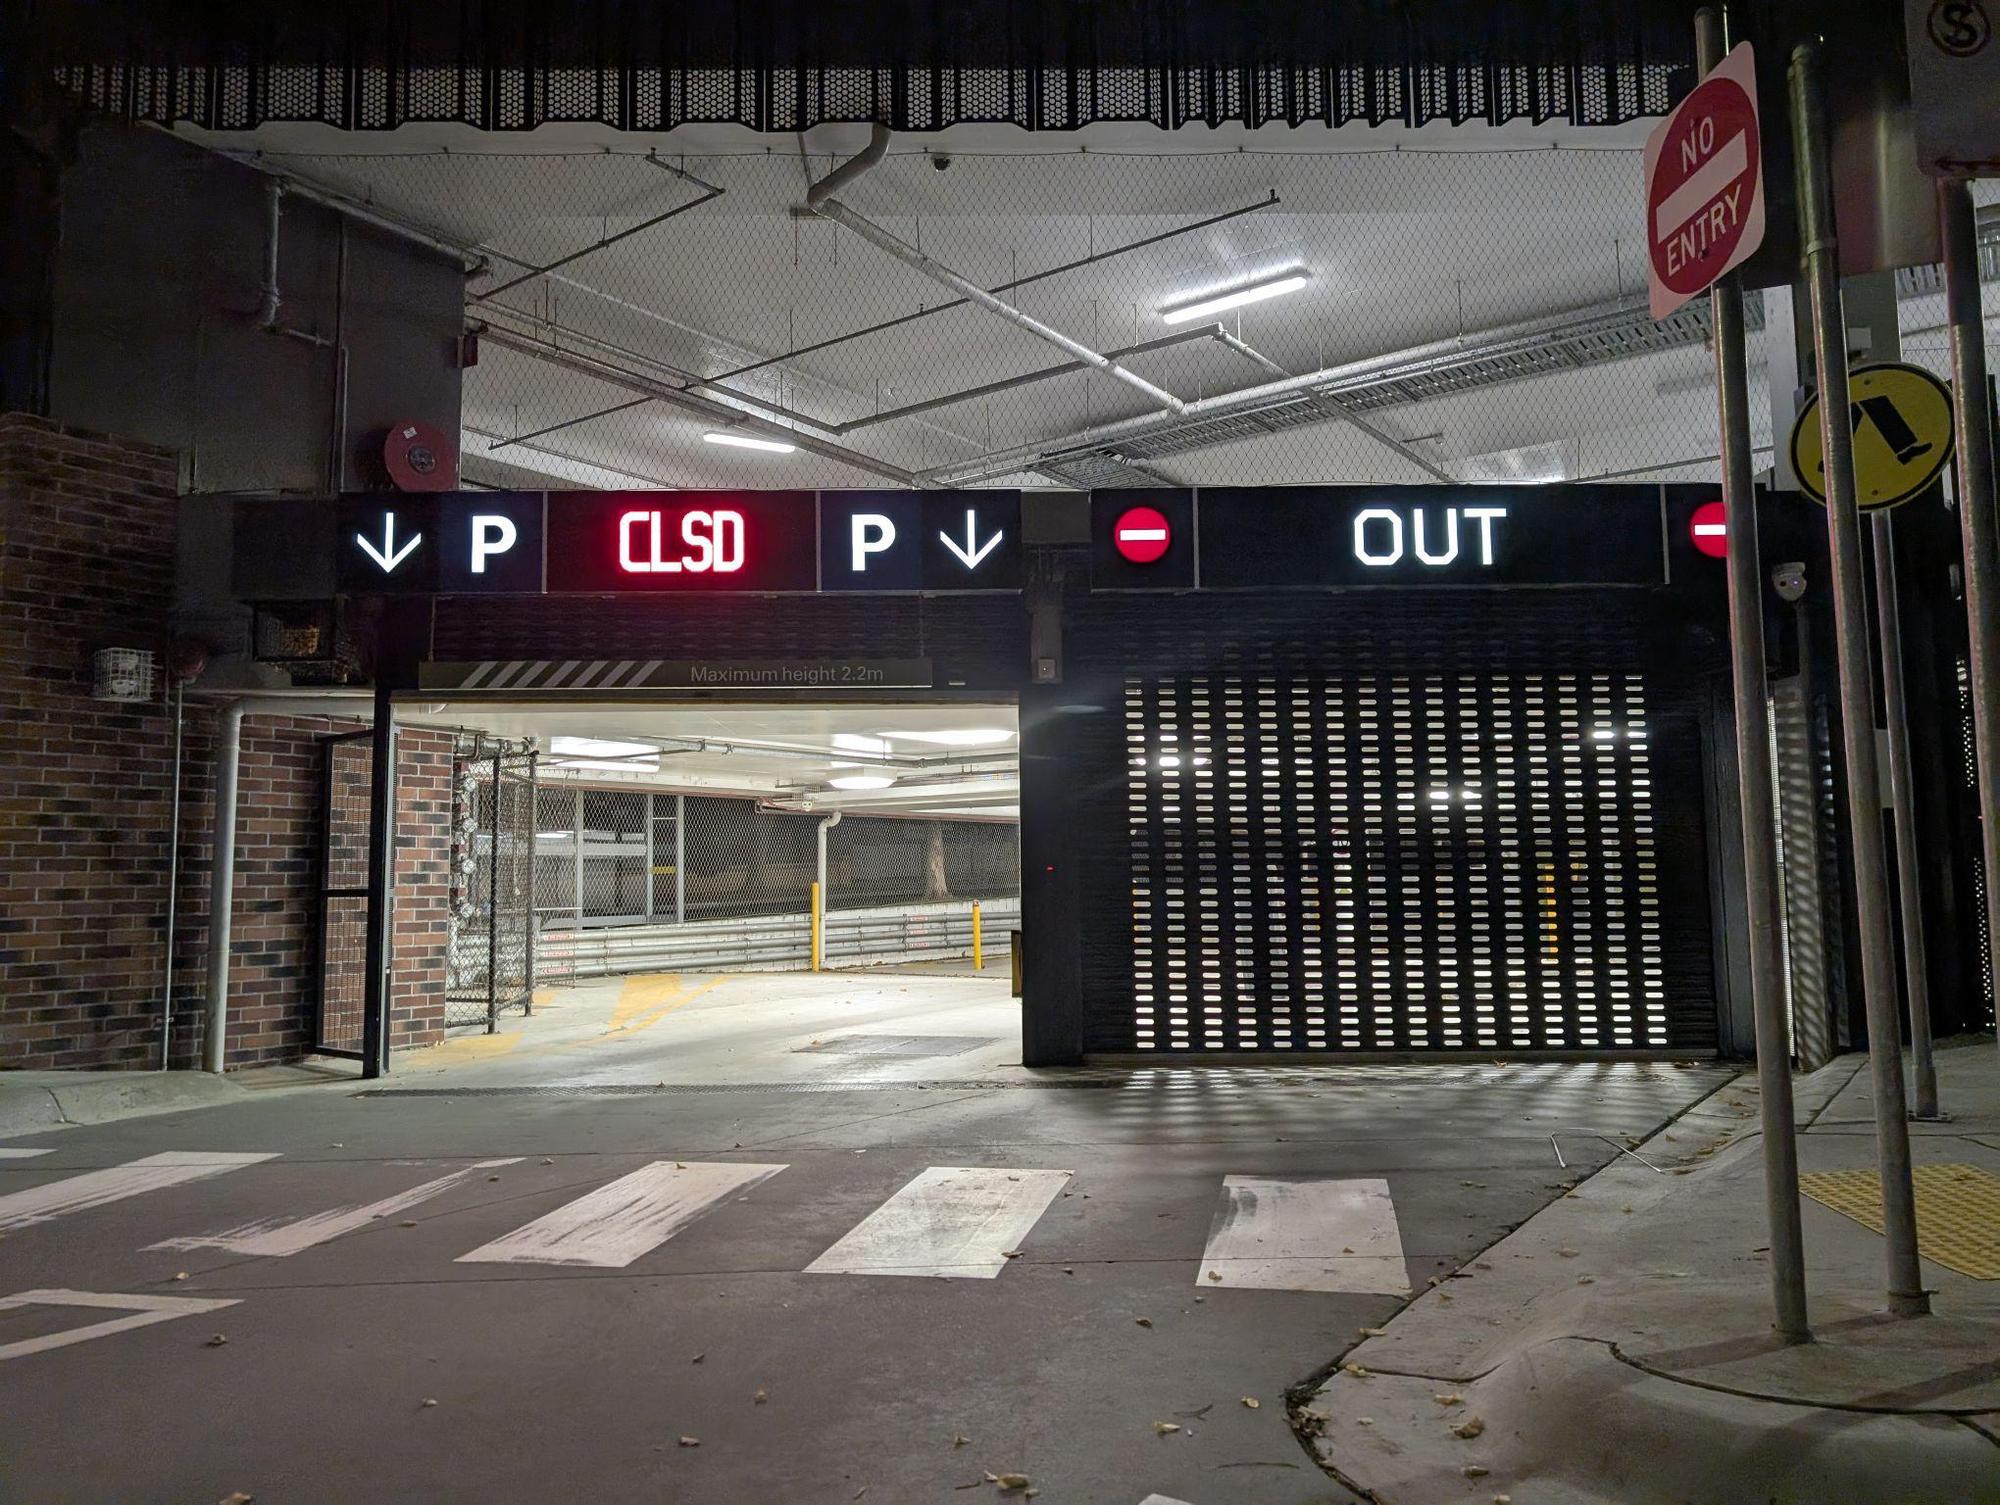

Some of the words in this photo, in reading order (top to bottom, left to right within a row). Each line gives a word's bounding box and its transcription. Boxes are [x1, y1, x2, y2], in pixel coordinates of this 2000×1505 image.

[1680, 115, 1714, 174] NO
[1666, 183, 1742, 277] ENTRY
[471, 514, 517, 574] P
[618, 510, 745, 573] CLSD
[851, 513, 896, 572] P
[1353, 507, 1507, 566] OUT
[690, 666, 779, 682] Maximum
[782, 665, 836, 685] height
[840, 665, 884, 682] 2.2m
